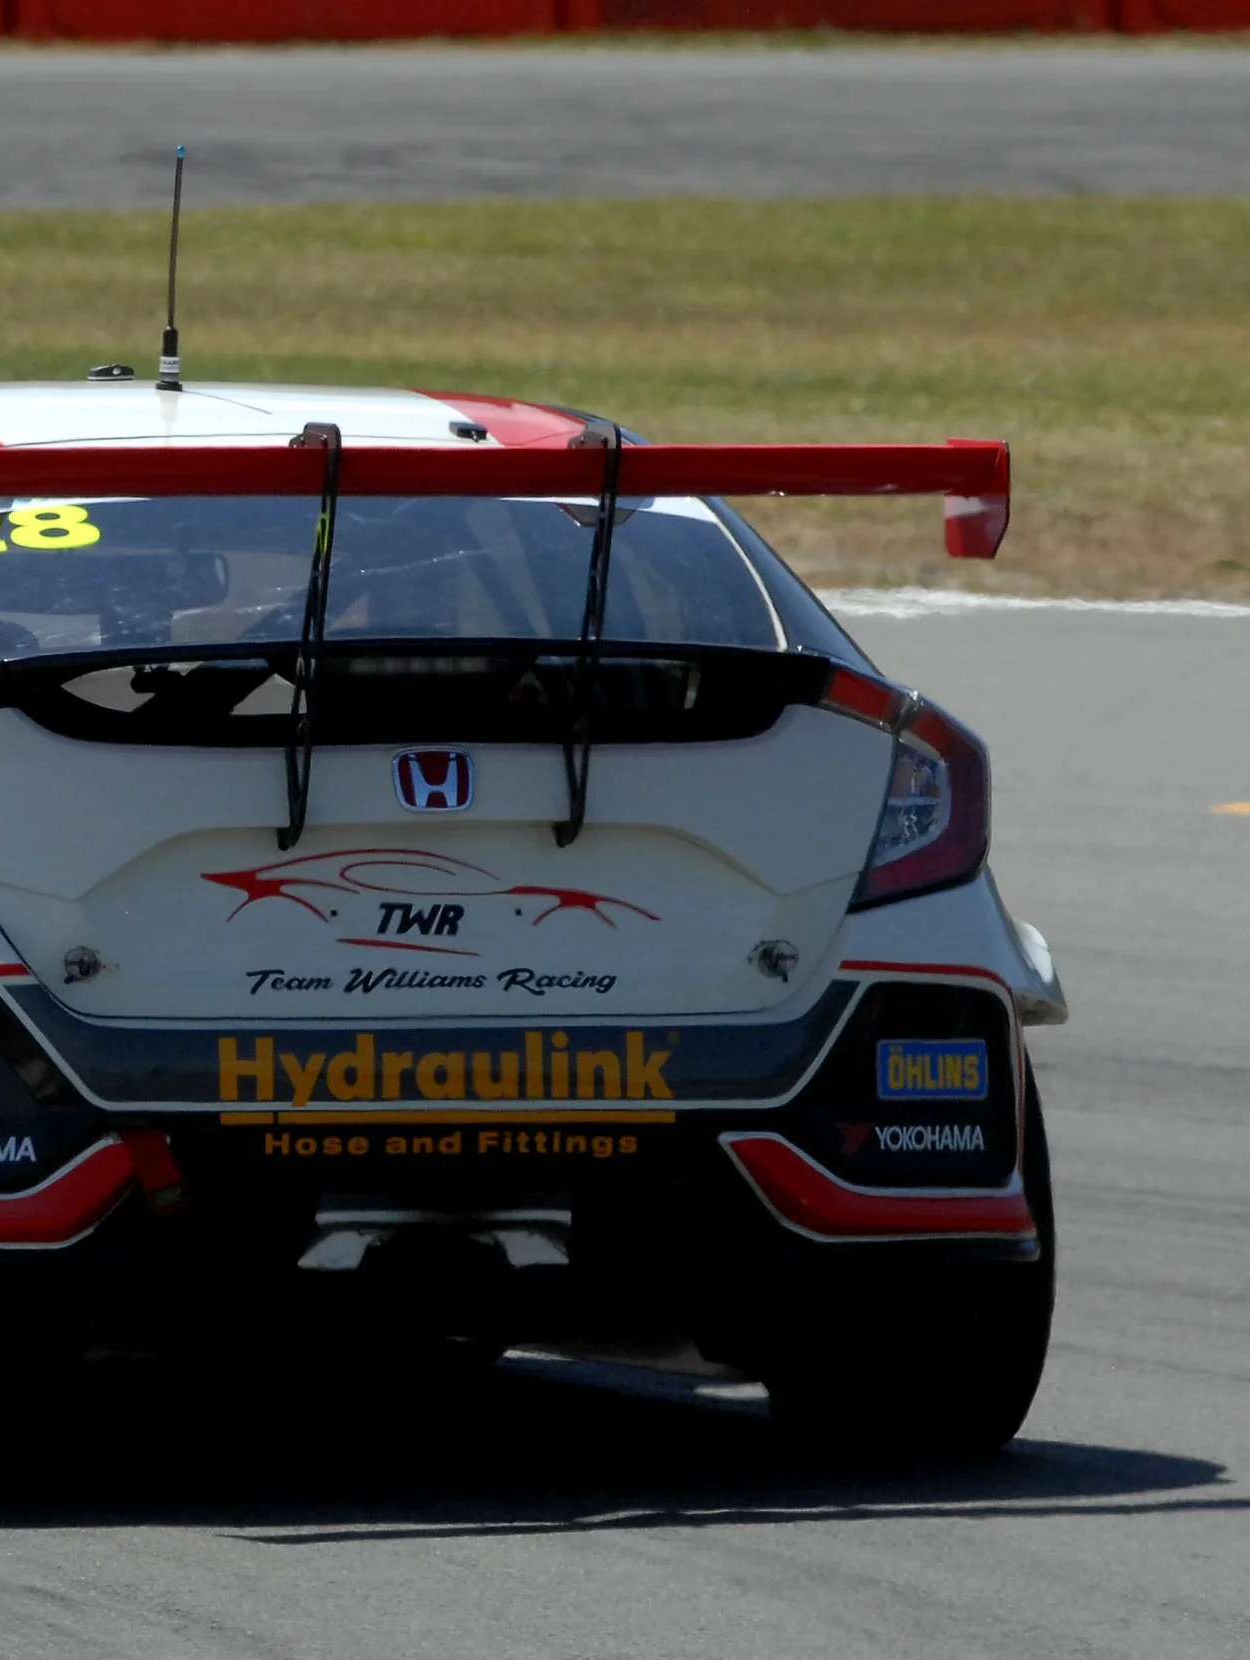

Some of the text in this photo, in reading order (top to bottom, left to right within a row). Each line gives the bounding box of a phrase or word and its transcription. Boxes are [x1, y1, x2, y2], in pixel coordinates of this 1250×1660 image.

[377, 902, 465, 937] TWR
[246, 967, 618, 996] Team Williams Racing
[217, 1030, 675, 1107] Hydraulink
[887, 1046, 981, 1091] ÖHLINS
[264, 1131, 639, 1158] Hose and Fittings
[875, 1125, 986, 1151] YOKOHAMA
